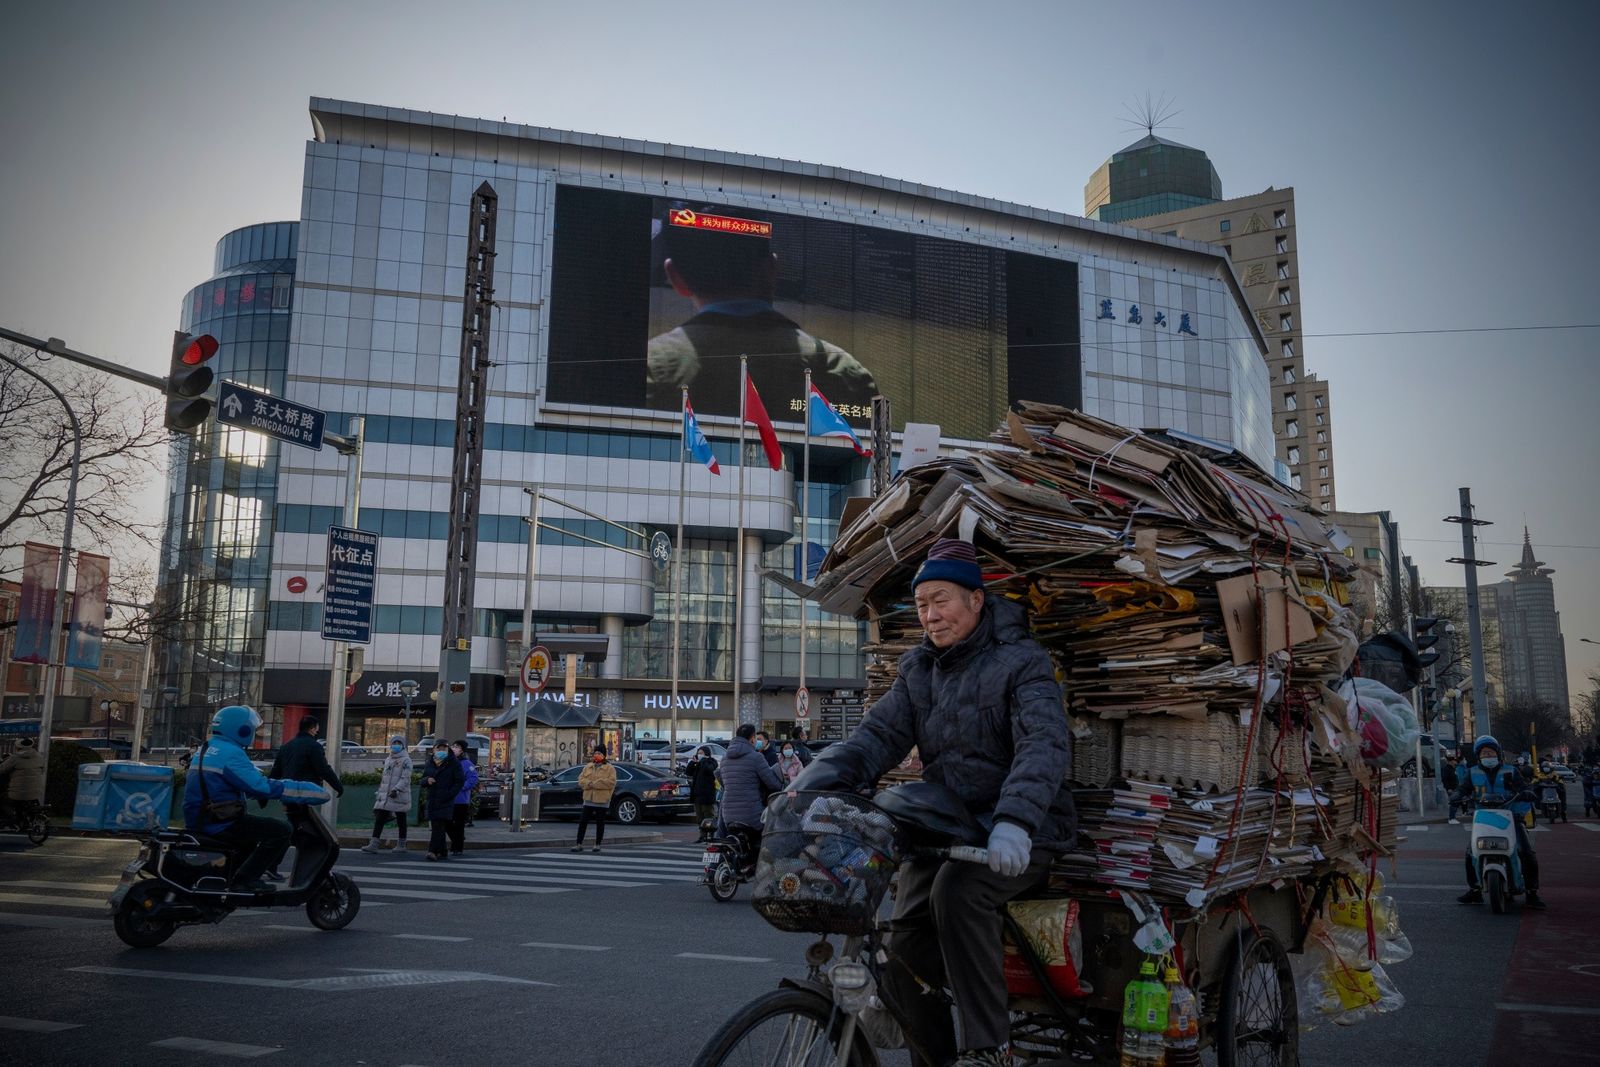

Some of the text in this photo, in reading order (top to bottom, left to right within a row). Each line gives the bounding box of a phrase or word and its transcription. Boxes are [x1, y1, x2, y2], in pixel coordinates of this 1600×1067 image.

[702, 216, 769, 234] 我为群众办实事
[253, 398, 315, 430] 东大桥路
[251, 415, 313, 442] DONGDAQIAO Rd
[331, 544, 374, 566] 代征点
[644, 694, 719, 710] HUAWEI
